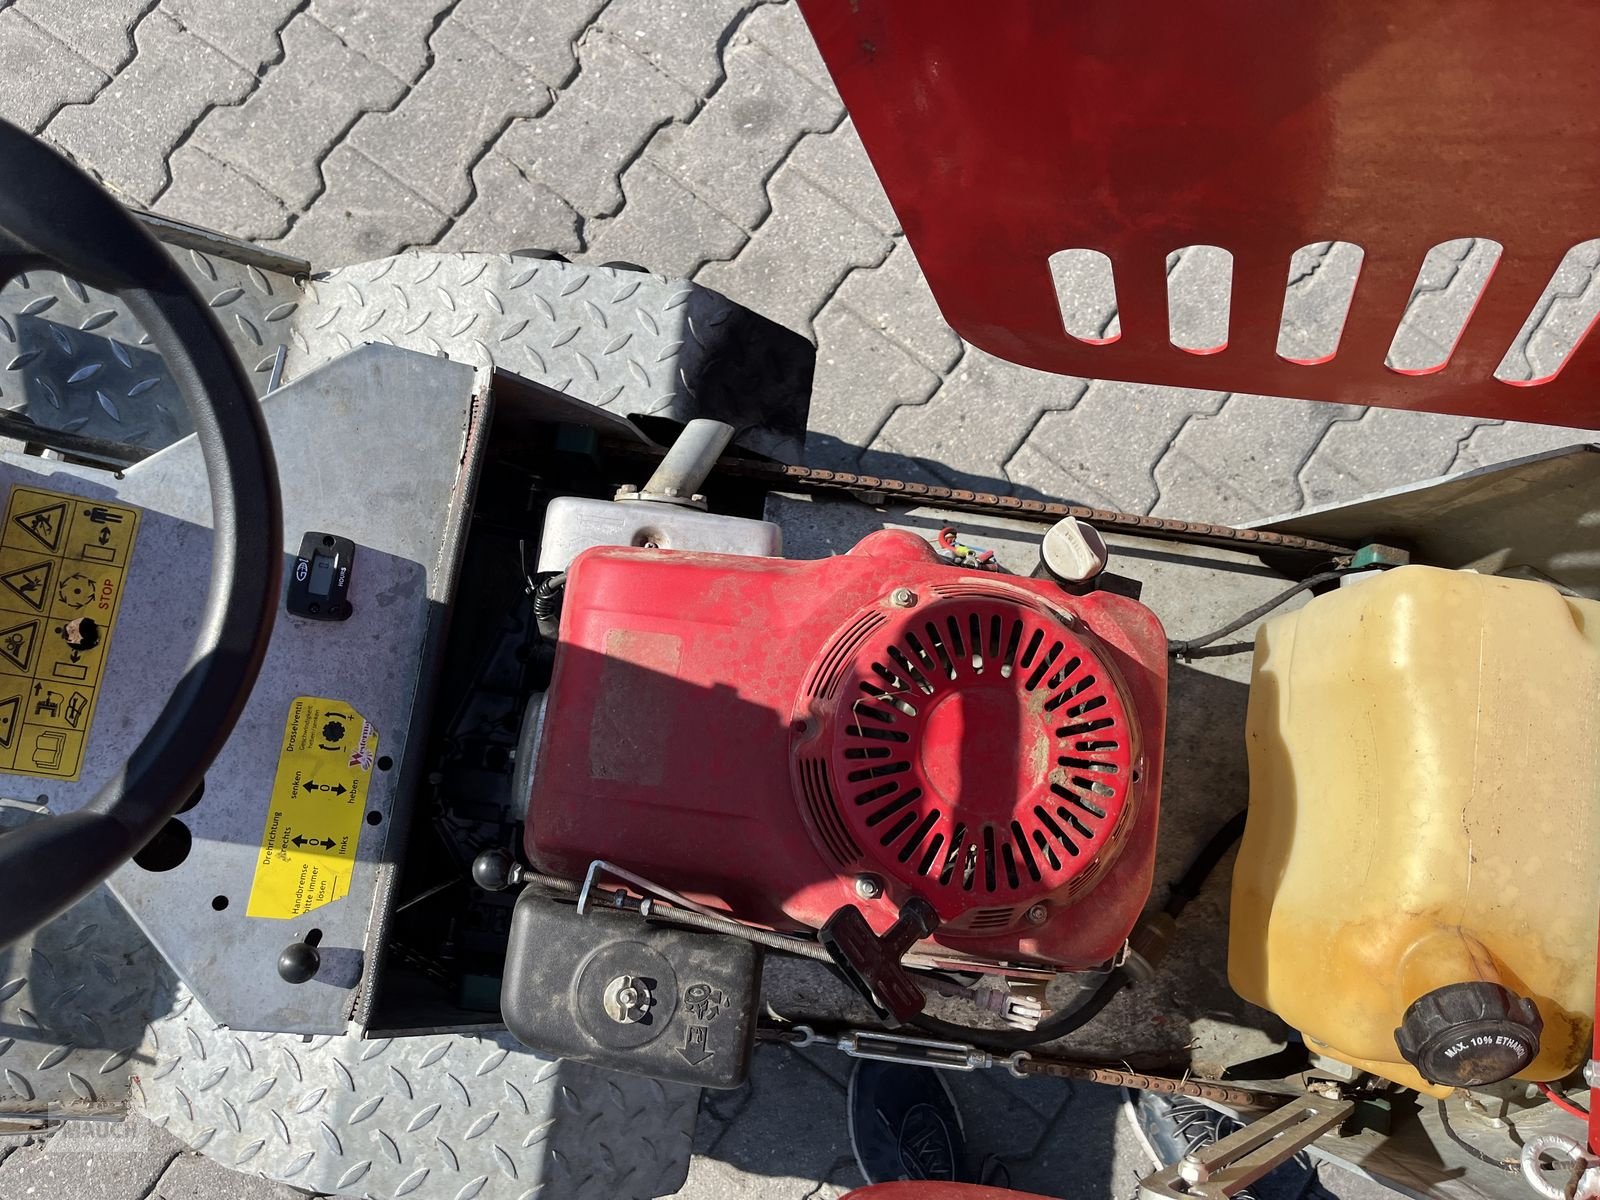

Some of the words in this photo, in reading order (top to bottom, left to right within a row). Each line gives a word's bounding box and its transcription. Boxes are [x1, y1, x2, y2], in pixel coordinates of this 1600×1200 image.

[338, 567, 347, 587] HOURS
[98, 578, 114, 610] STOP
[286, 701, 303, 752] Drosselventil
[291, 770, 302, 799] senken
[347, 779, 359, 804] heben
[262, 811, 282, 865] Drehrichtung
[281, 826, 292, 851] rechts
[338, 836, 349, 855] links
[291, 863, 309, 914] Handbremse
[307, 865, 319, 892] immer
[302, 894, 314, 914] bitte
[1444, 1041, 1469, 1058] MAX.
[1470, 1035, 1493, 1046] 10%
[1495, 1035, 1526, 1060] ETHANOL
